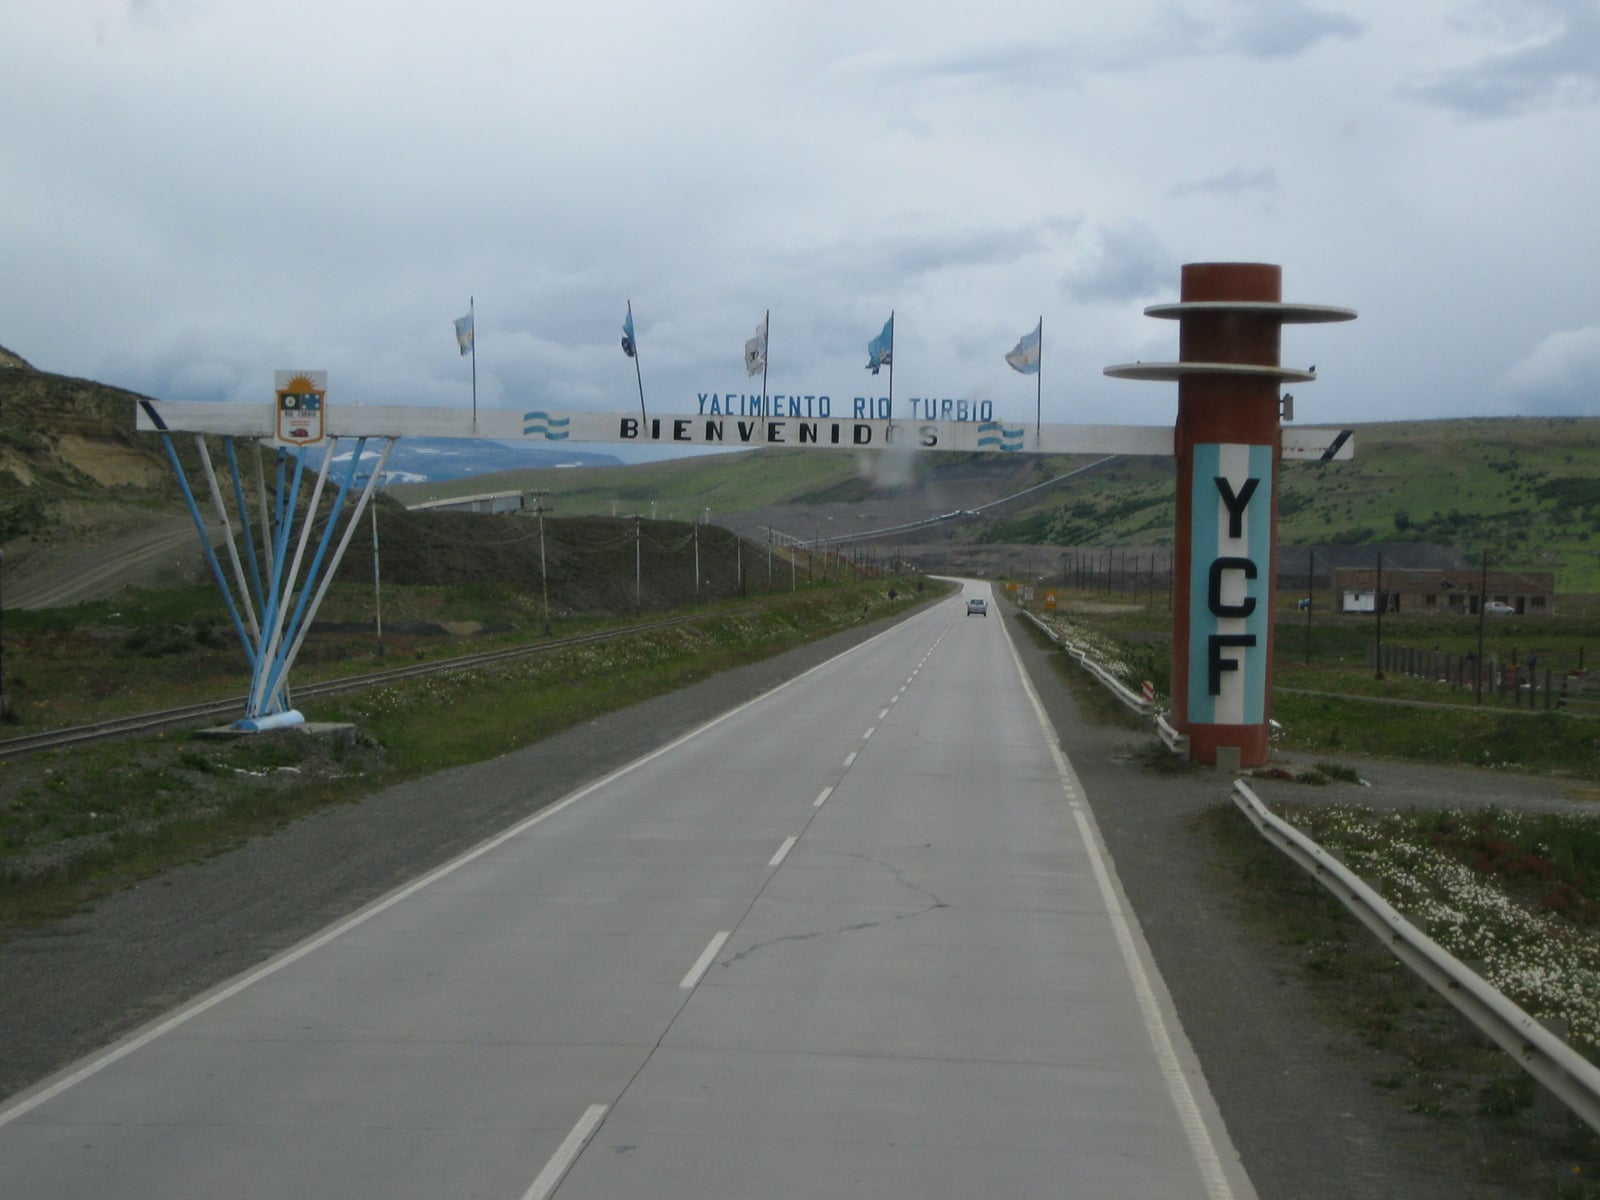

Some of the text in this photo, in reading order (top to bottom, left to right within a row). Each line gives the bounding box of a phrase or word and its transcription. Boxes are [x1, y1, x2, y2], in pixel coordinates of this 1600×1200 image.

[697, 393, 993, 422] YACIMIENTO RIO TURBIO
[1208, 476, 1261, 696] YCF
